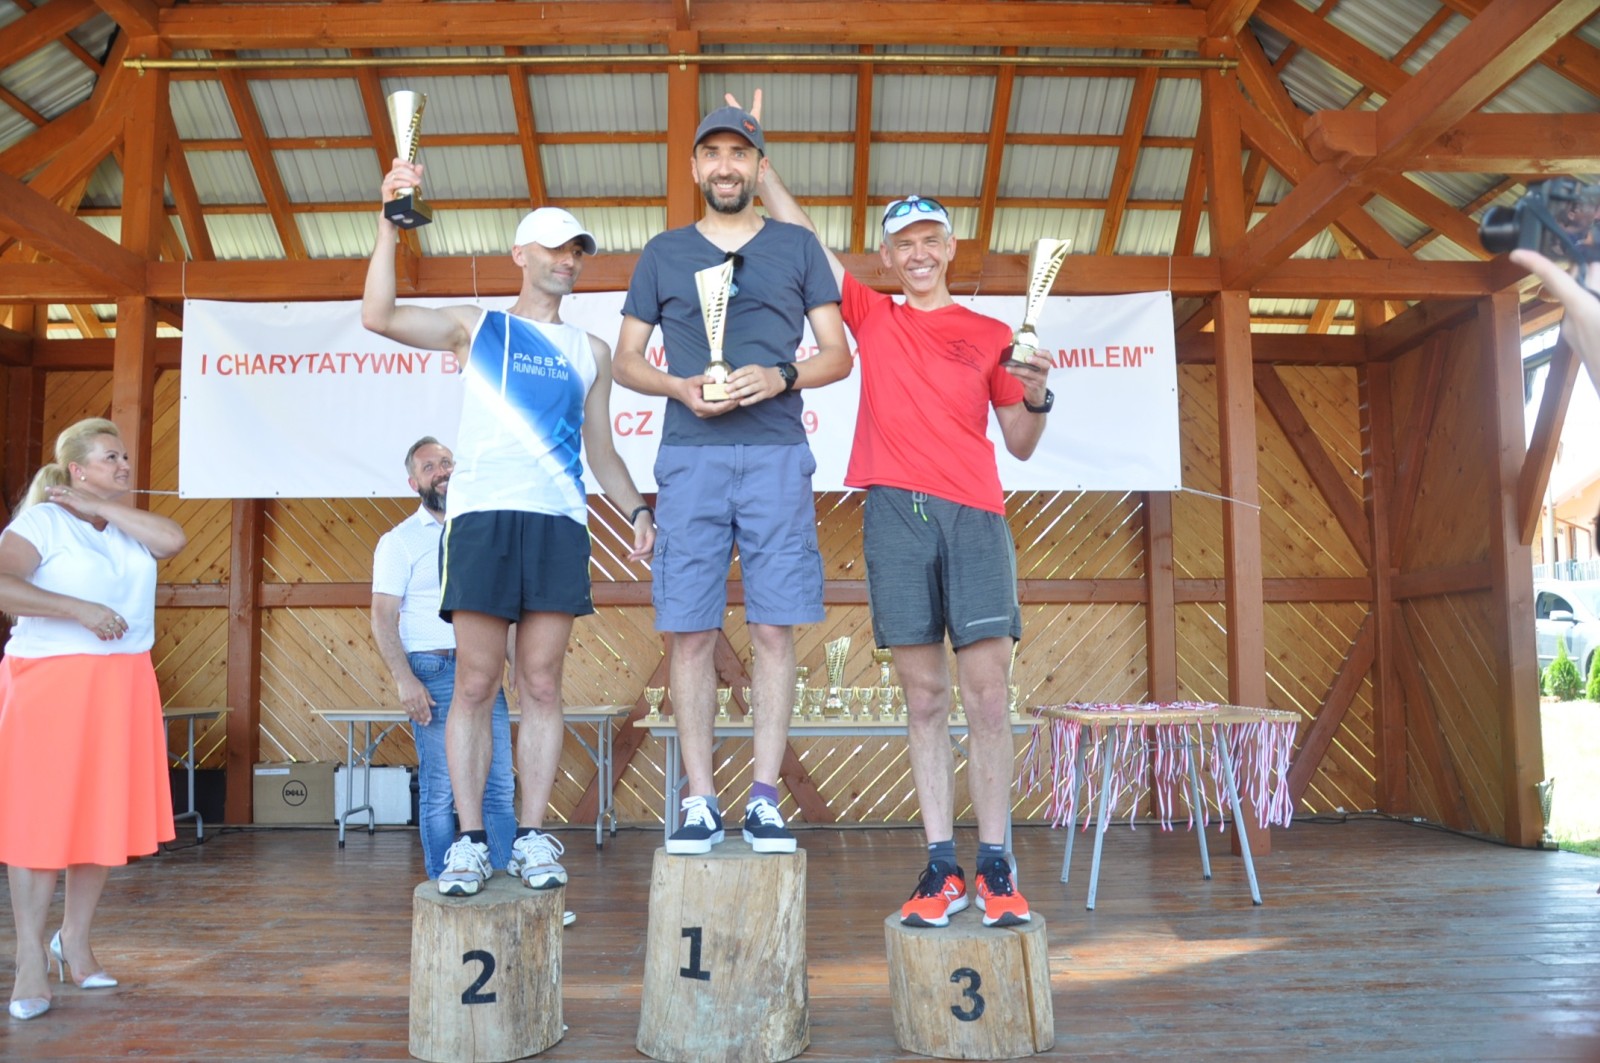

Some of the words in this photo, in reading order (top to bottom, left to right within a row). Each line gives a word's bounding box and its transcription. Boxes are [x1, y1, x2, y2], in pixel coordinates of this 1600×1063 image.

[201, 354, 207, 375] I
[216, 352, 432, 376] CHARYTATYWNY
[513, 352, 554, 367] PASS
[513, 361, 546, 377] RUNNING
[548, 367, 569, 382] TEAM
[285, 789, 305, 797] DELL
[679, 926, 711, 982] 1
[461, 949, 497, 1005] 2
[950, 967, 986, 1022] 3
